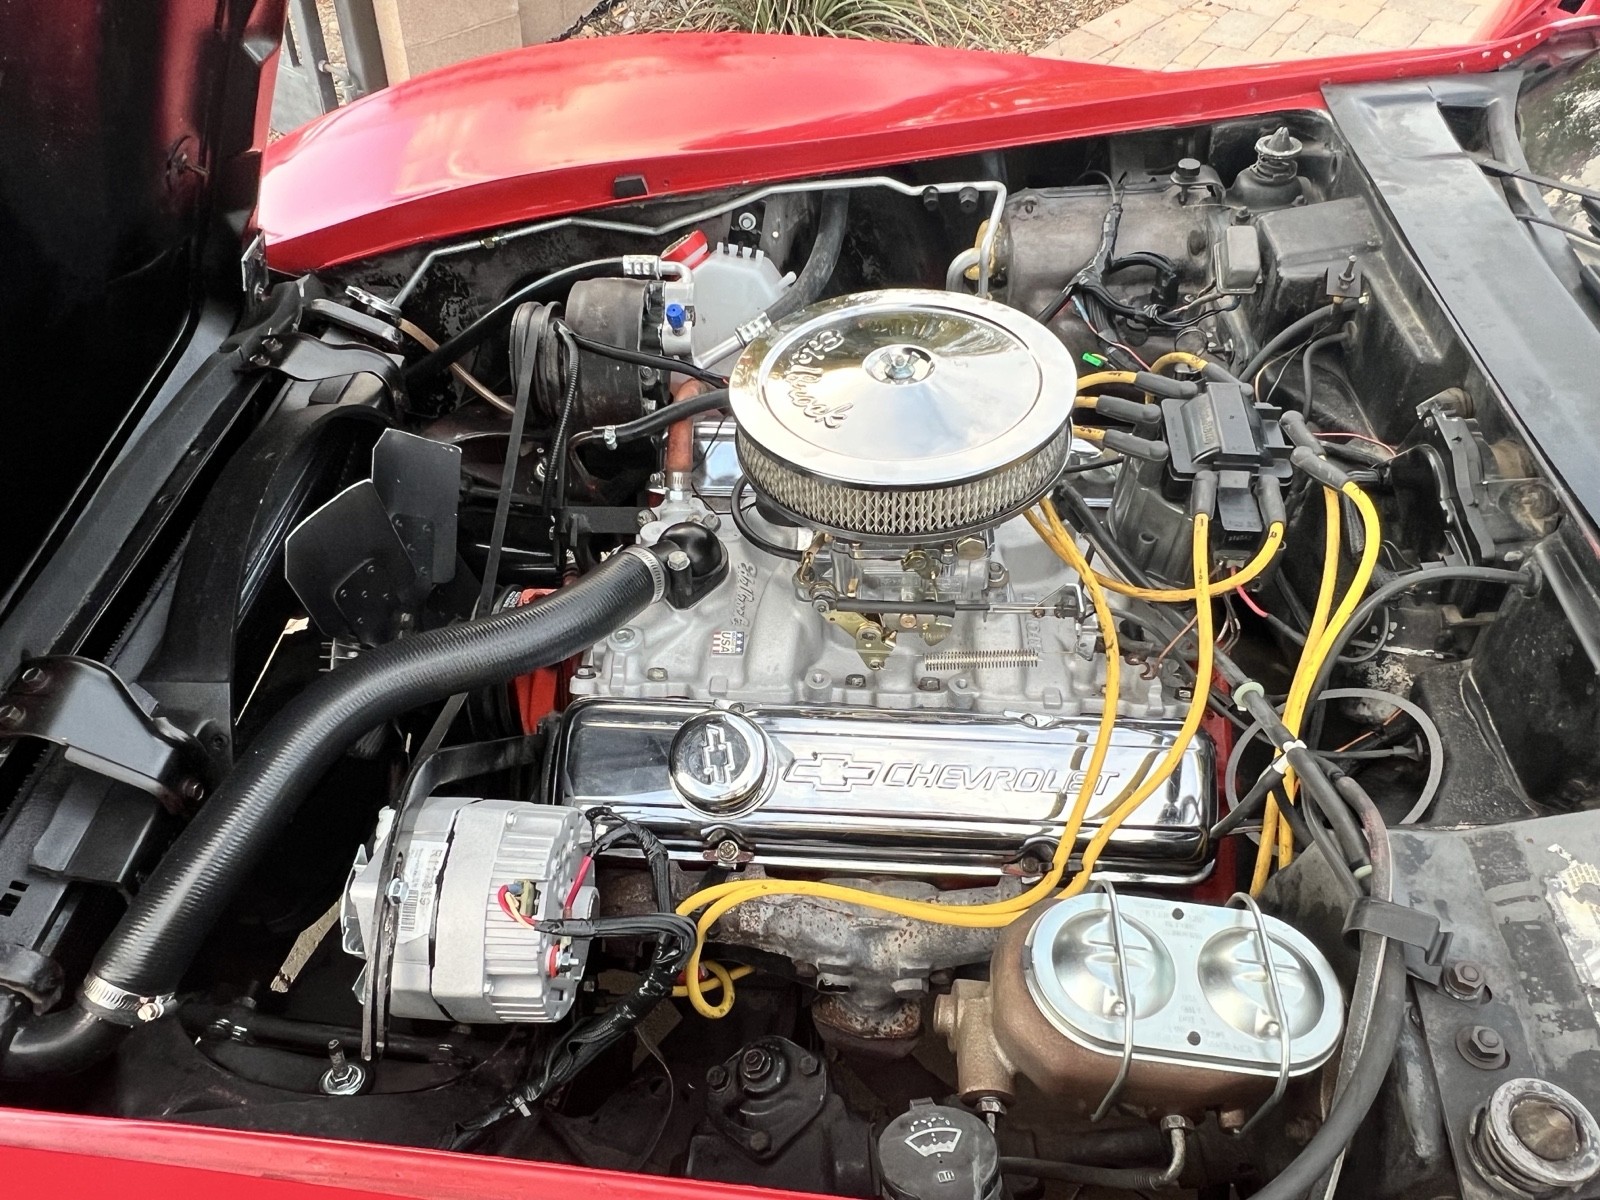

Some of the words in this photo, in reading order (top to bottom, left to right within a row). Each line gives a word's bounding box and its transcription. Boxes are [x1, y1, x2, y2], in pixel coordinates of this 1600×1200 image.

[784, 329, 853, 429] Edelbrock
[730, 562, 758, 627] Edelbrock
[720, 631, 731, 653] USA
[883, 761, 1120, 796] CHEVROLET
